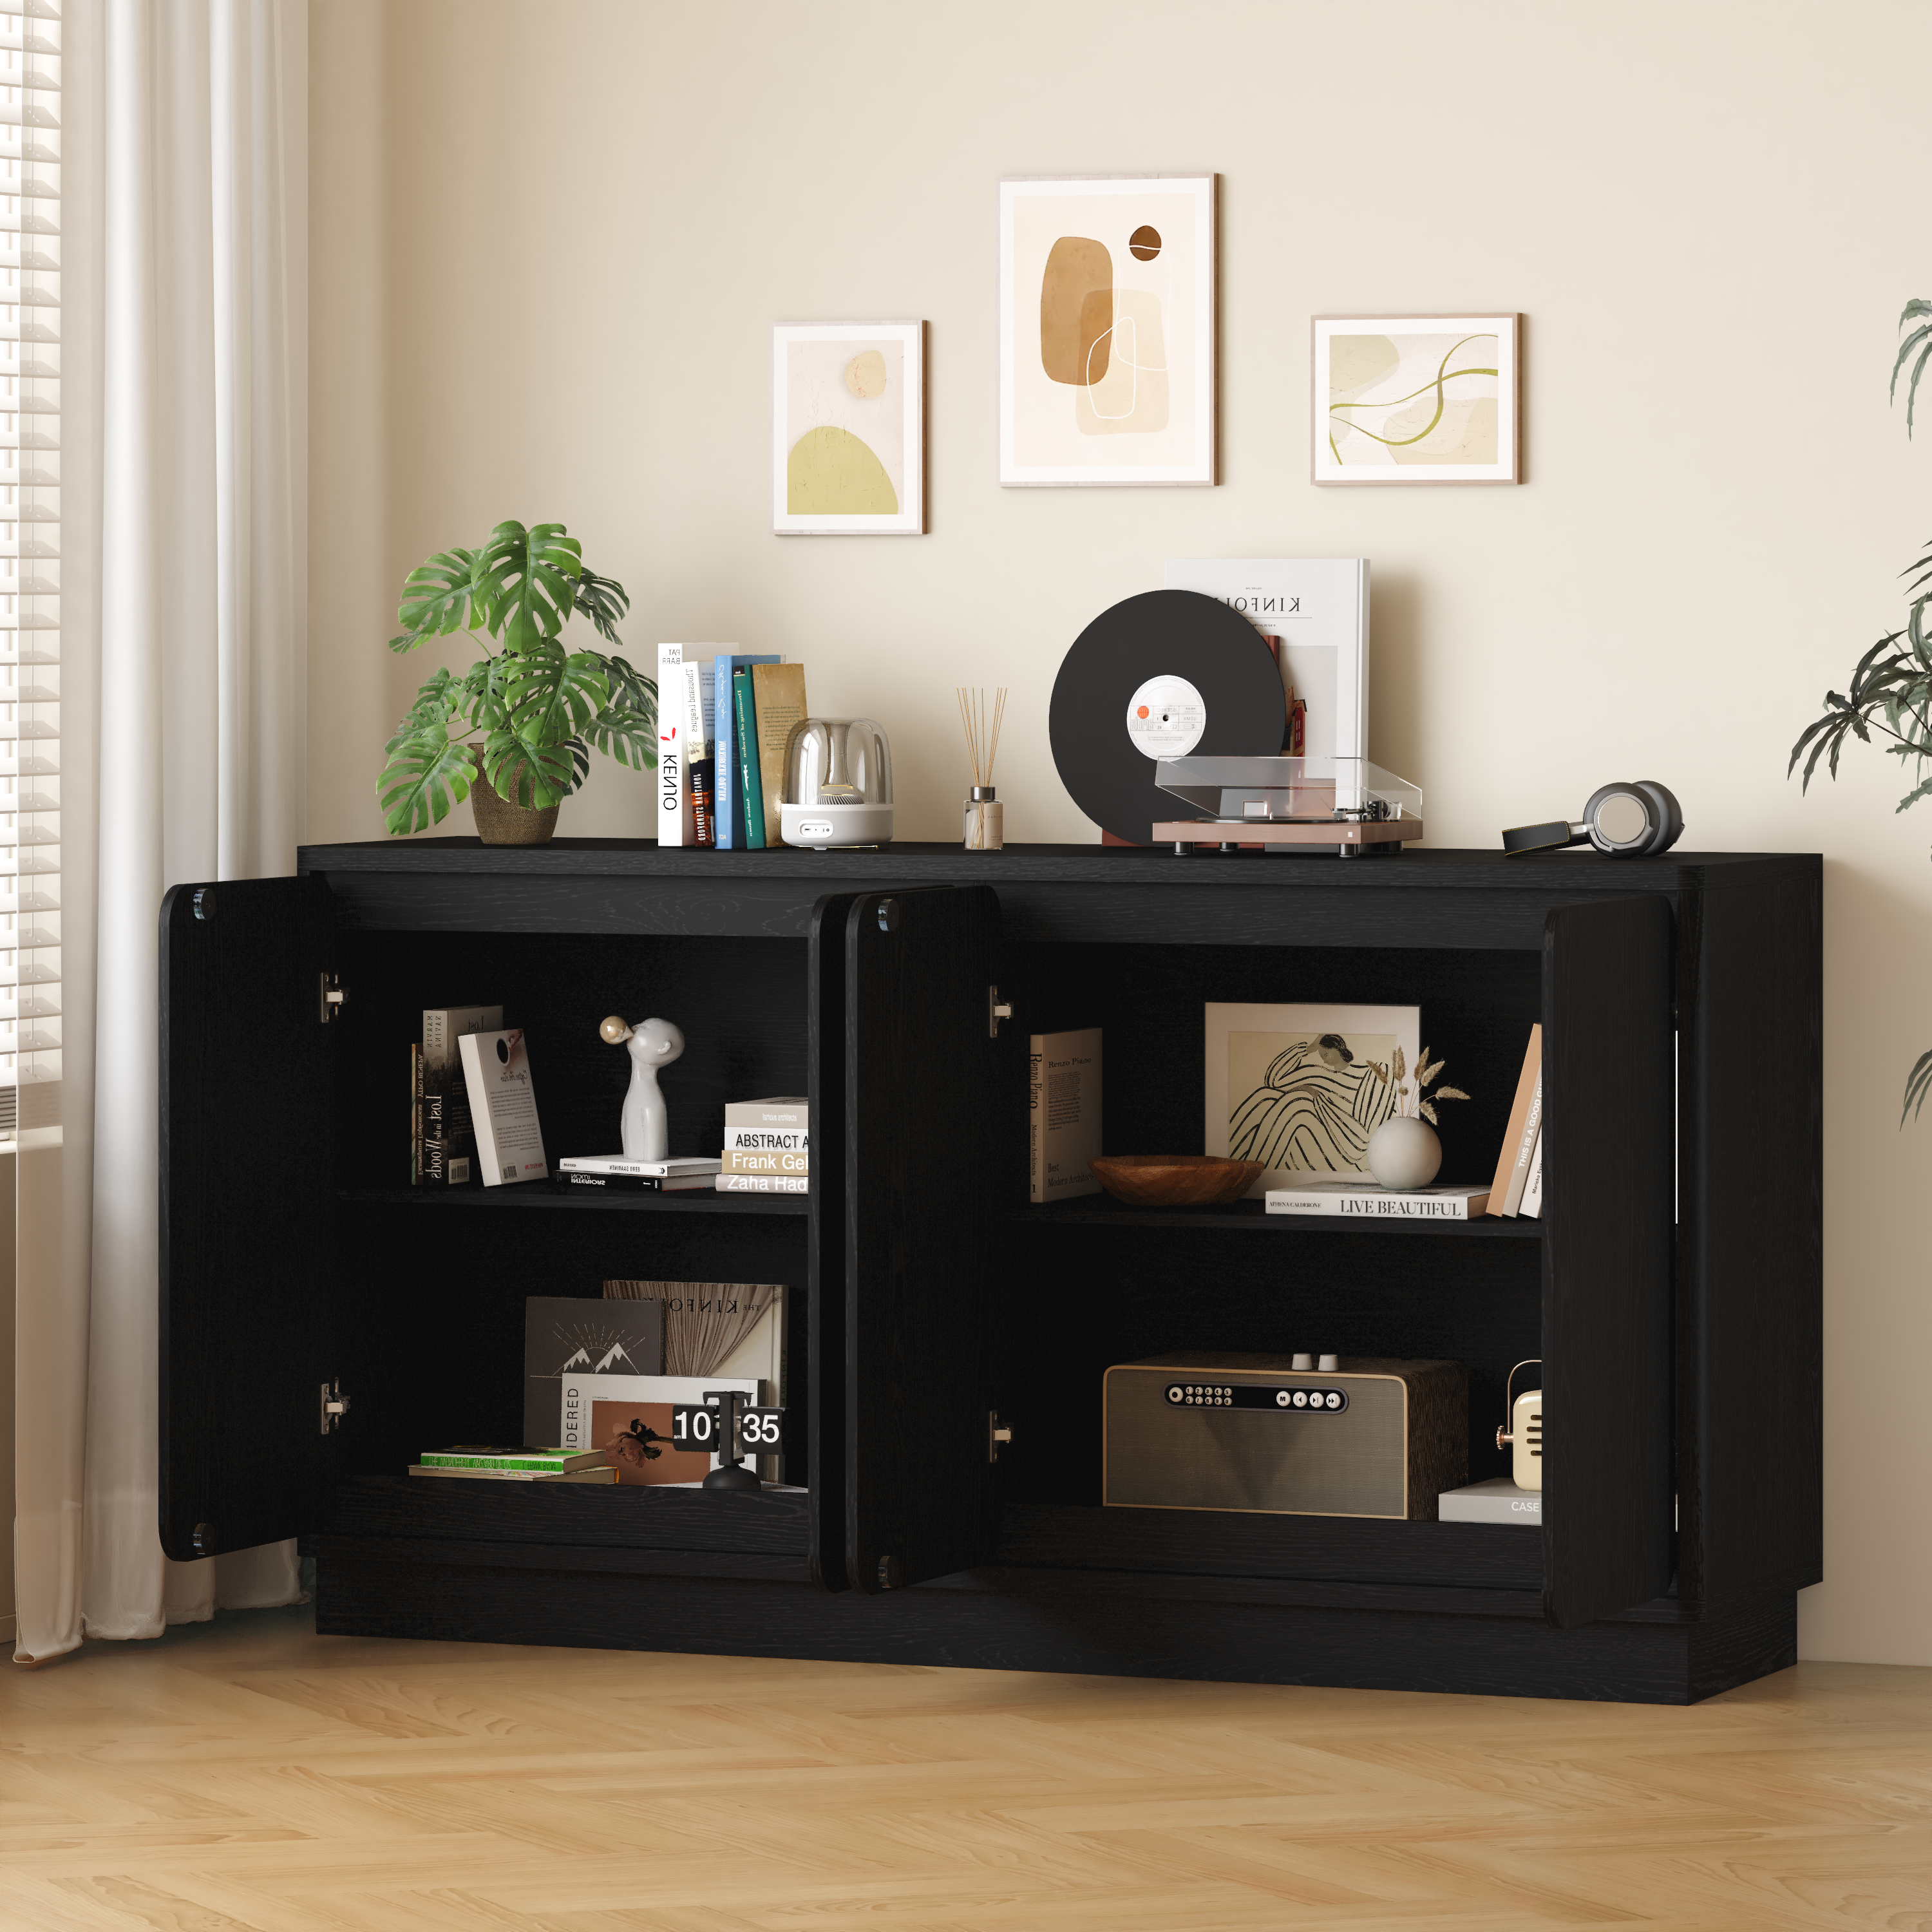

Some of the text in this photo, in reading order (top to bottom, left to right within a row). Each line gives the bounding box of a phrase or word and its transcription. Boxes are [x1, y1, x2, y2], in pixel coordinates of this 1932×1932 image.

[1048, 1057, 1092, 1069] Renzo Piano
[762, 1113, 797, 1122] famous architects
[735, 1134, 799, 1148] ABSTRACT
[1518, 1147, 1530, 1168] THIS
[1524, 1137, 1532, 1146] IS
[1529, 1099, 1541, 1127] GOOD
[732, 1153, 777, 1169] Frank
[1048, 1163, 1059, 1173] Best
[728, 1175, 769, 1191] Zaha
[1048, 1171, 1094, 1188] Modern Architects
[1031, 1184, 1037, 1193] 1
[1340, 1200, 1461, 1217] LIVE BEAUTIFUL
[675, 1411, 780, 1443] 10 35
[1511, 1501, 1540, 1512] CASE
